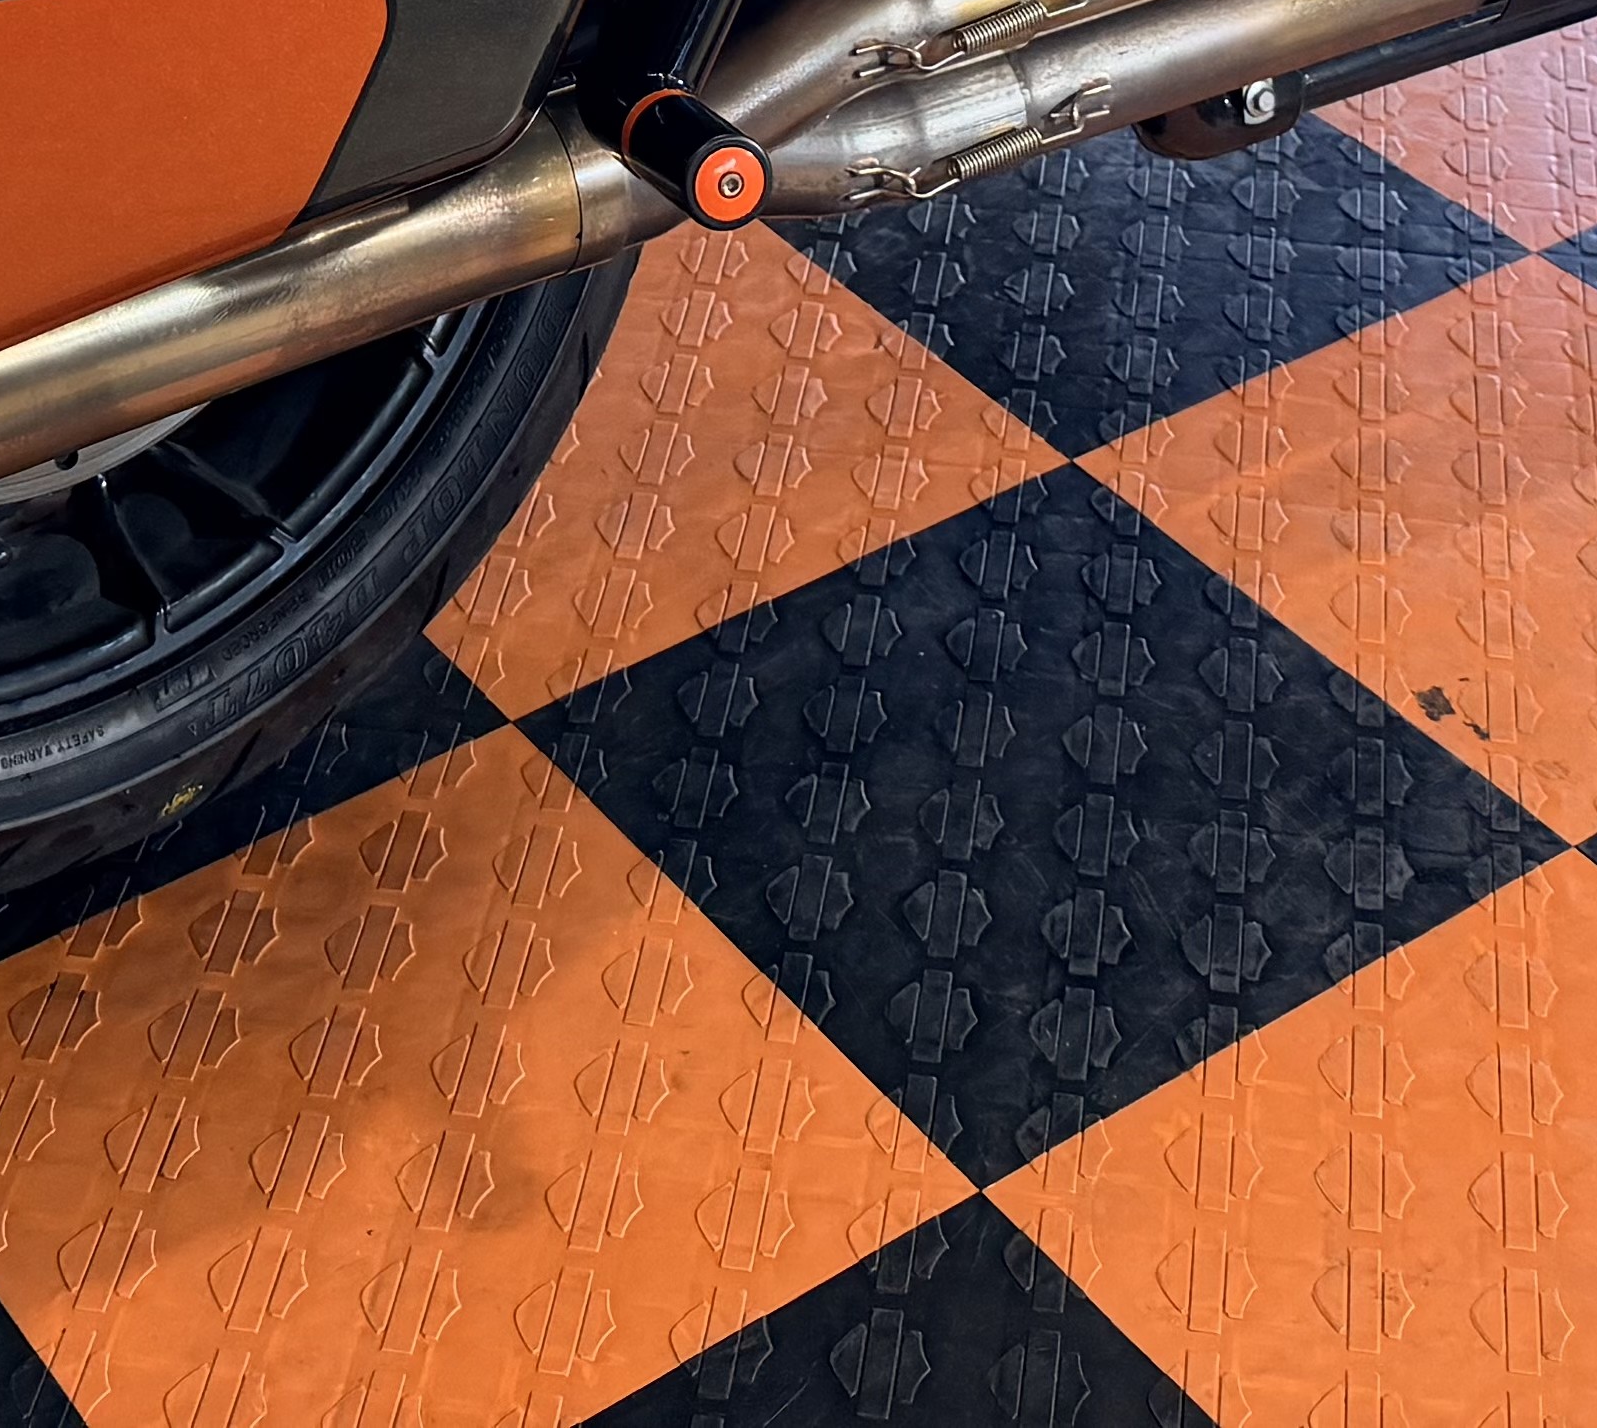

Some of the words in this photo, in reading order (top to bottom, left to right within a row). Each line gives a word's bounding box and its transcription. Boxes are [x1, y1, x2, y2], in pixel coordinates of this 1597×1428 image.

[404, 297, 569, 570] DUNLOP
[204, 567, 381, 732] D407T
[55, 724, 105, 753] SAFETY
